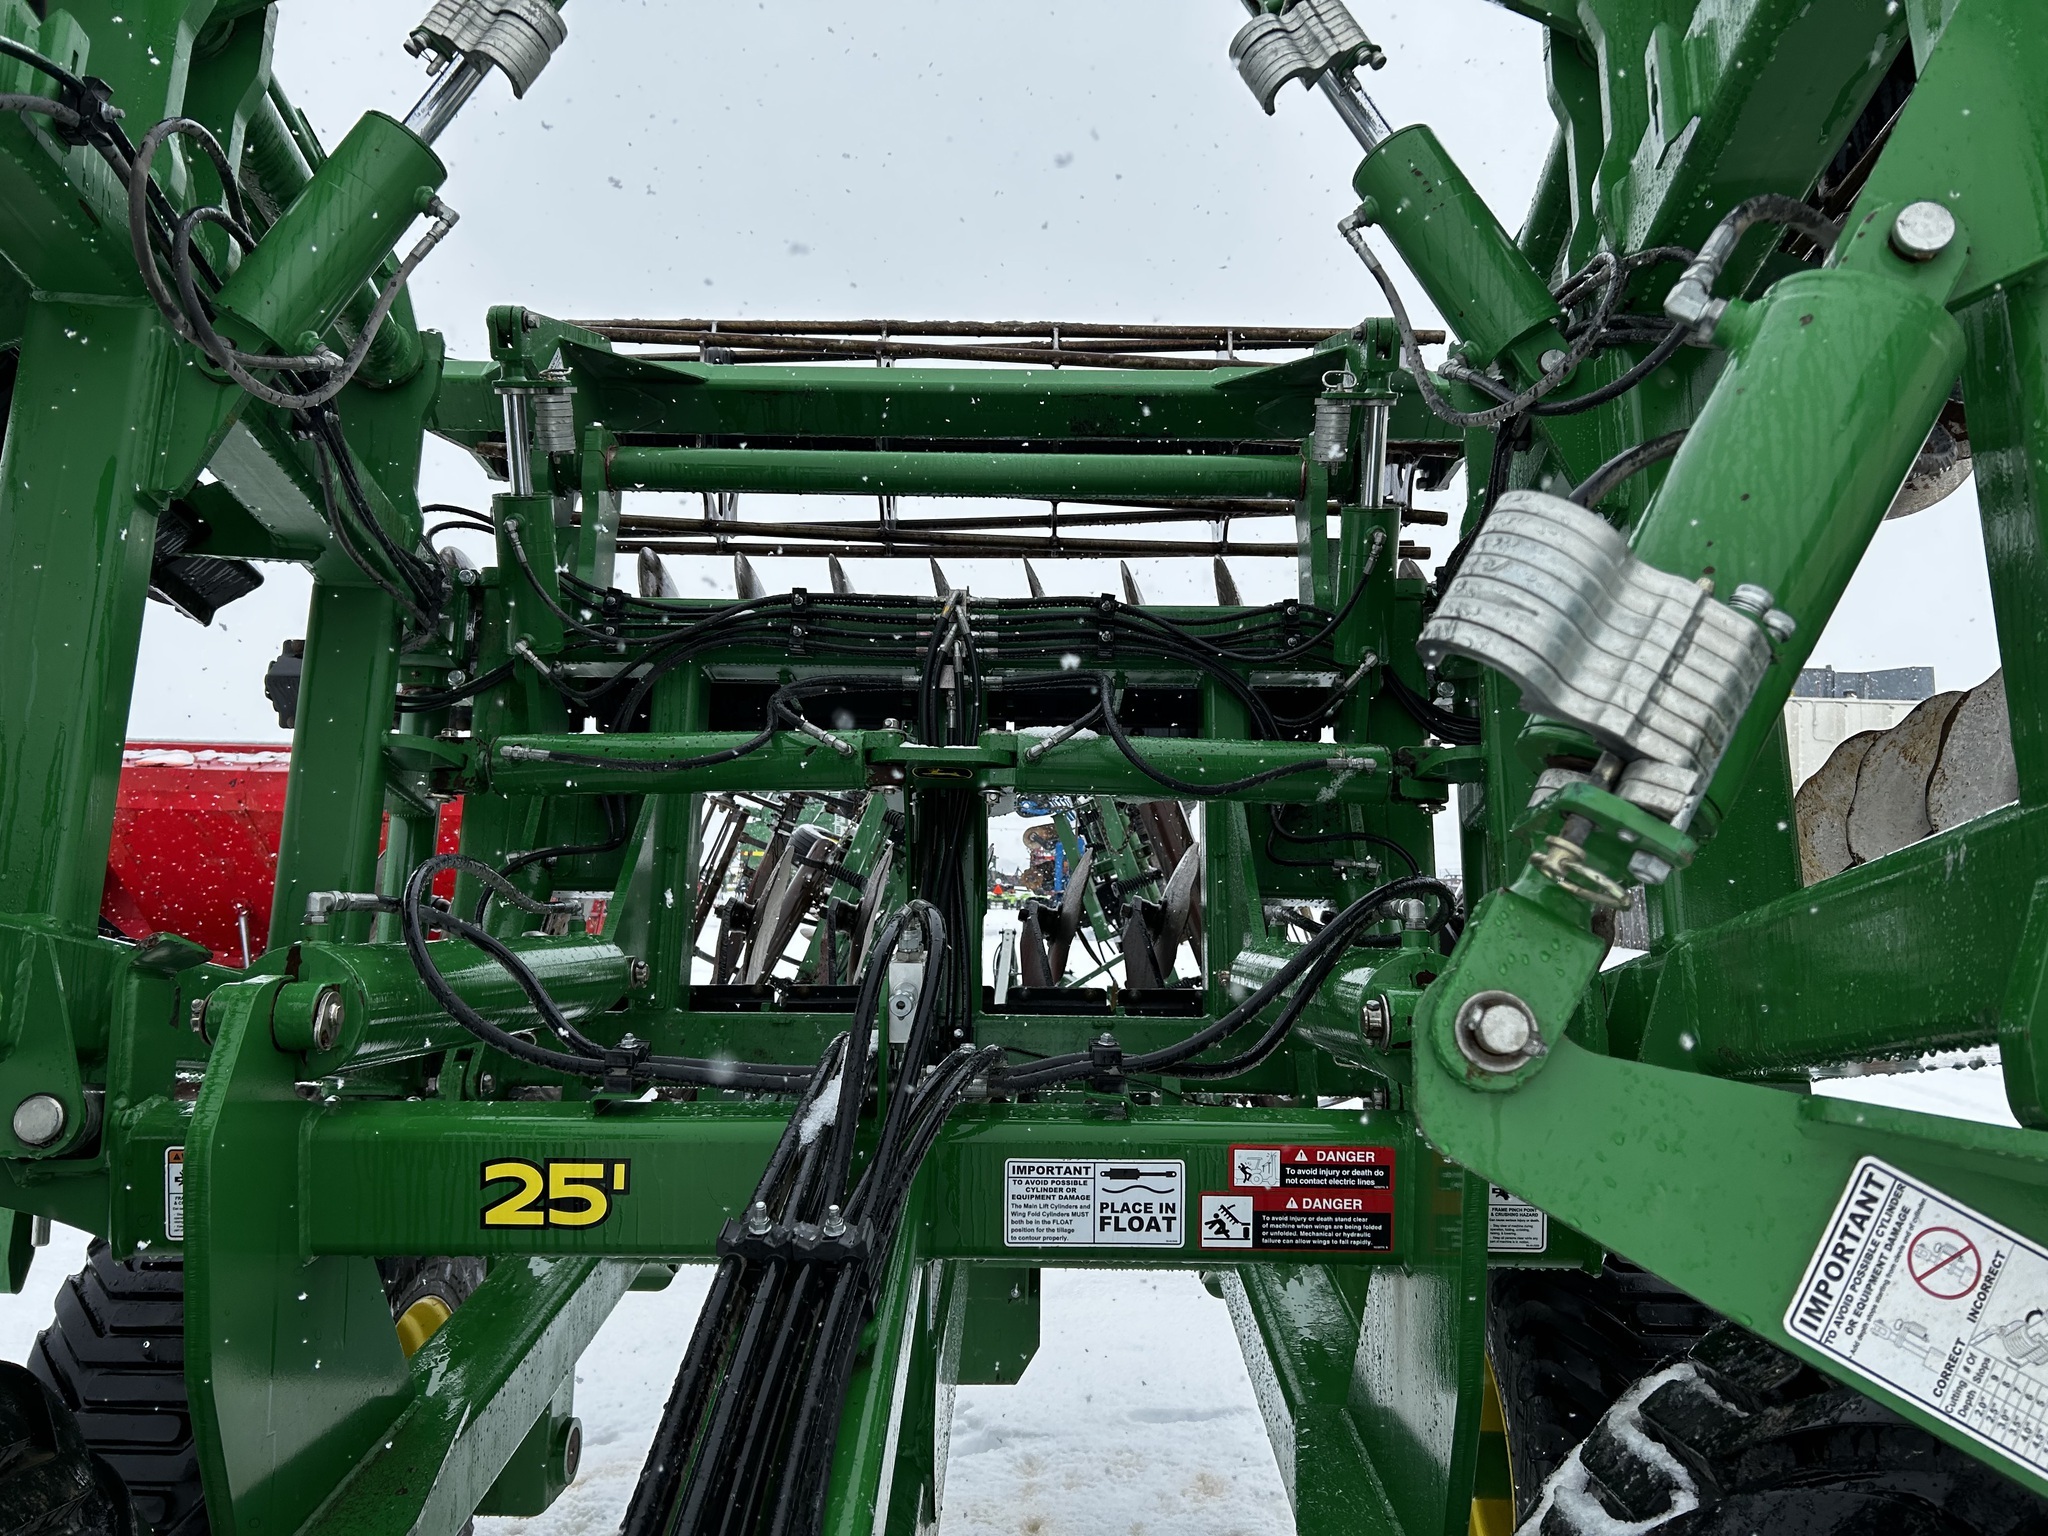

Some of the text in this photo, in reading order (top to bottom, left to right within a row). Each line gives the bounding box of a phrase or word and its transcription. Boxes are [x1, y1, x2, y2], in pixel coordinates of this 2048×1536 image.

[1317, 1151, 1375, 1162] DANGER
[1012, 1166, 1091, 1175] IMPORTANT
[1319, 1168, 1340, 1177] injury
[481, 1158, 630, 1229] 25'
[1303, 1199, 1362, 1210] DANGER
[1100, 1203, 1176, 1214] PLACE IN
[1100, 1216, 1176, 1232] FLOAT
[1799, 1172, 1885, 1332] IMPORTANT
[1824, 1183, 1906, 1345] TO AVOID POSSIBLE CYLINDER
[1845, 1205, 1911, 1336] OR EQUIPMENT DAMAGE
[1967, 1250, 2006, 1324] INCORRECT
[1933, 1337, 1965, 1398] CORRECT
[1966, 1352, 1977, 1365] Of
[1973, 1357, 1991, 1384] Stops
[1945, 1380, 1968, 1414] Cutting
[1958, 1390, 1977, 1418] Depth
